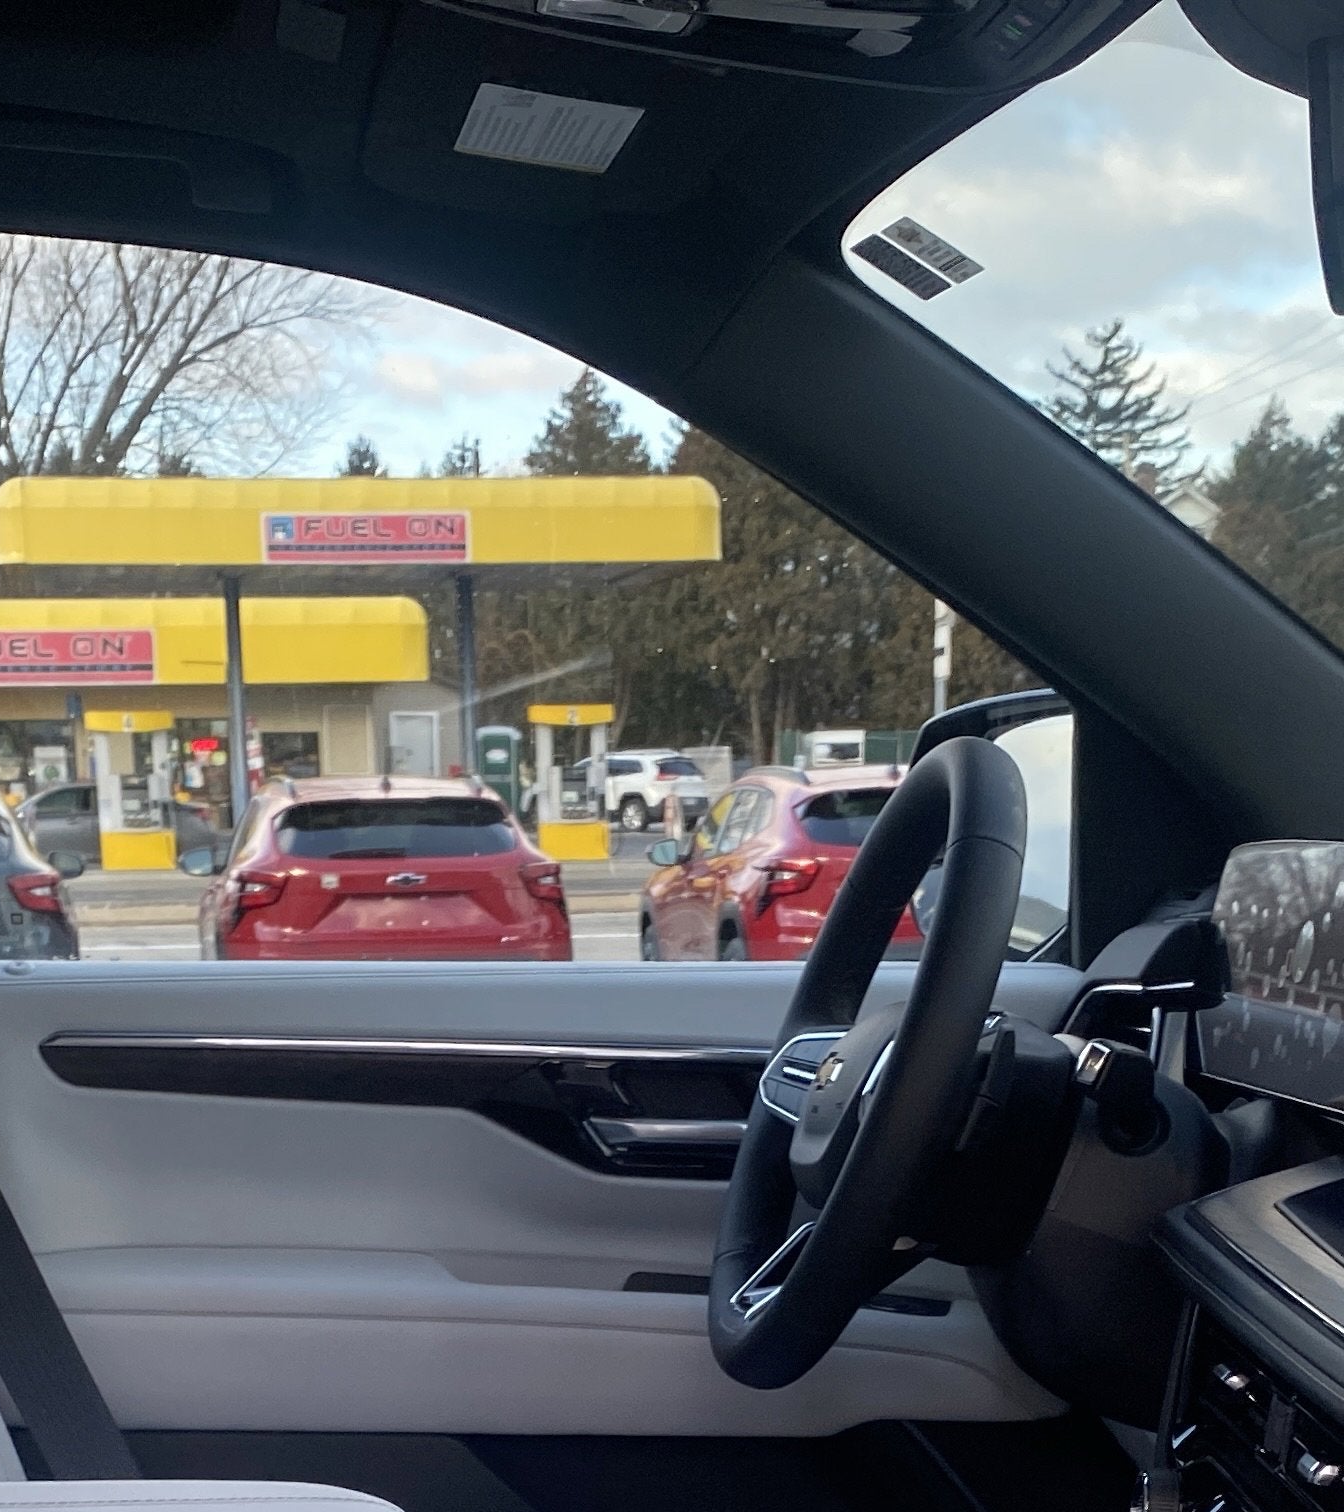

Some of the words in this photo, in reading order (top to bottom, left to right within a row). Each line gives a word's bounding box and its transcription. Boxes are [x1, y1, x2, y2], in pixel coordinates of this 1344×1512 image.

[304, 518, 392, 538] FUEL
[408, 518, 455, 537] ON
[71, 636, 125, 656] ON
